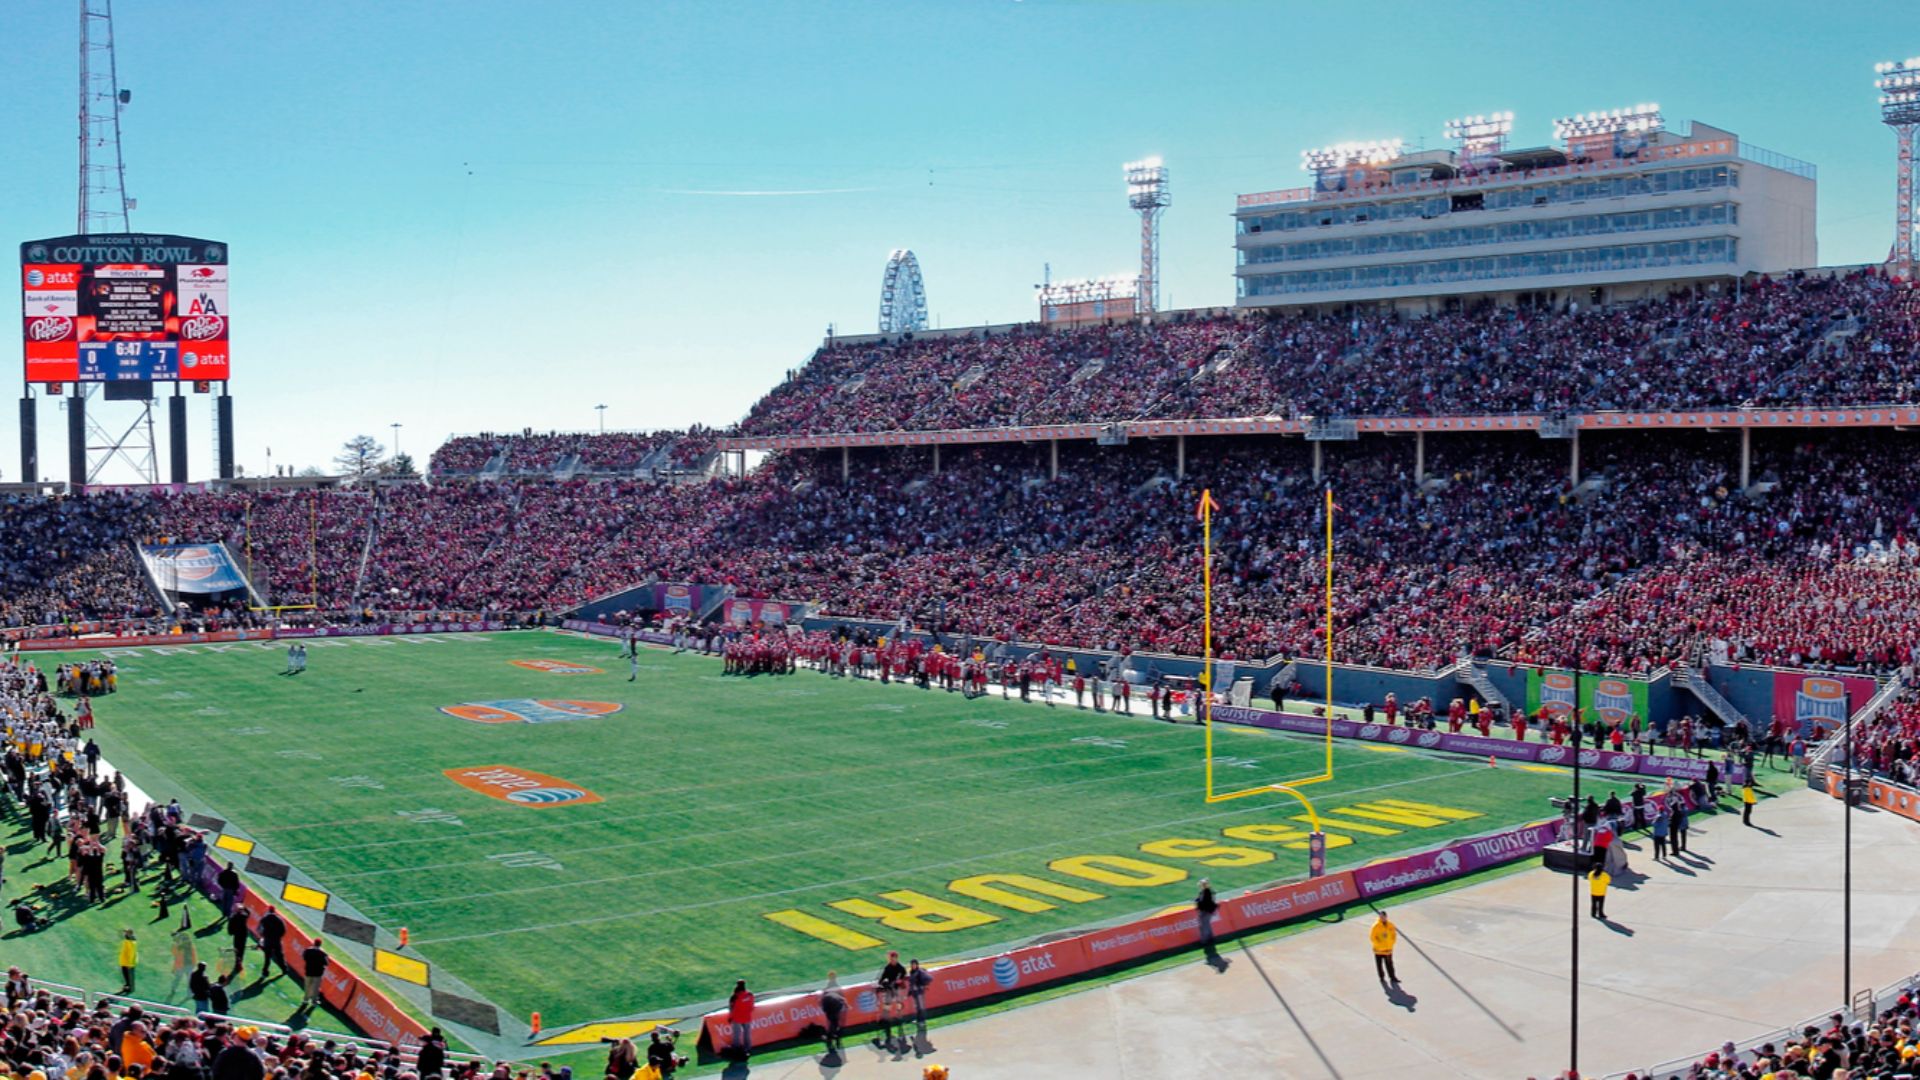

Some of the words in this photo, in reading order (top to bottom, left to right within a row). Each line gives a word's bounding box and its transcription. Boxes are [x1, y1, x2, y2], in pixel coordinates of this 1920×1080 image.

[89, 237, 132, 245] WELCOME
[134, 237, 145, 245] TO
[53, 246, 135, 263] COTTON
[141, 246, 198, 262] BOWL
[46, 271, 75, 284] at&t
[87, 350, 97, 364] 0
[115, 342, 141, 356] 6:47
[157, 350, 166, 364] 7
[200, 353, 227, 365] at&t
[1210, 706, 1265, 721] monster
[1799, 699, 1846, 720] COTTON
[1472, 828, 1542, 858] monster
[763, 800, 1485, 951] MISSOURI
[1240, 895, 1291, 919] Wireless
[1293, 890, 1318, 908] from
[1320, 879, 1345, 900] AT&T
[1020, 951, 1056, 976] at&t
[944, 976, 966, 992] The
[967, 972, 990, 987] new
